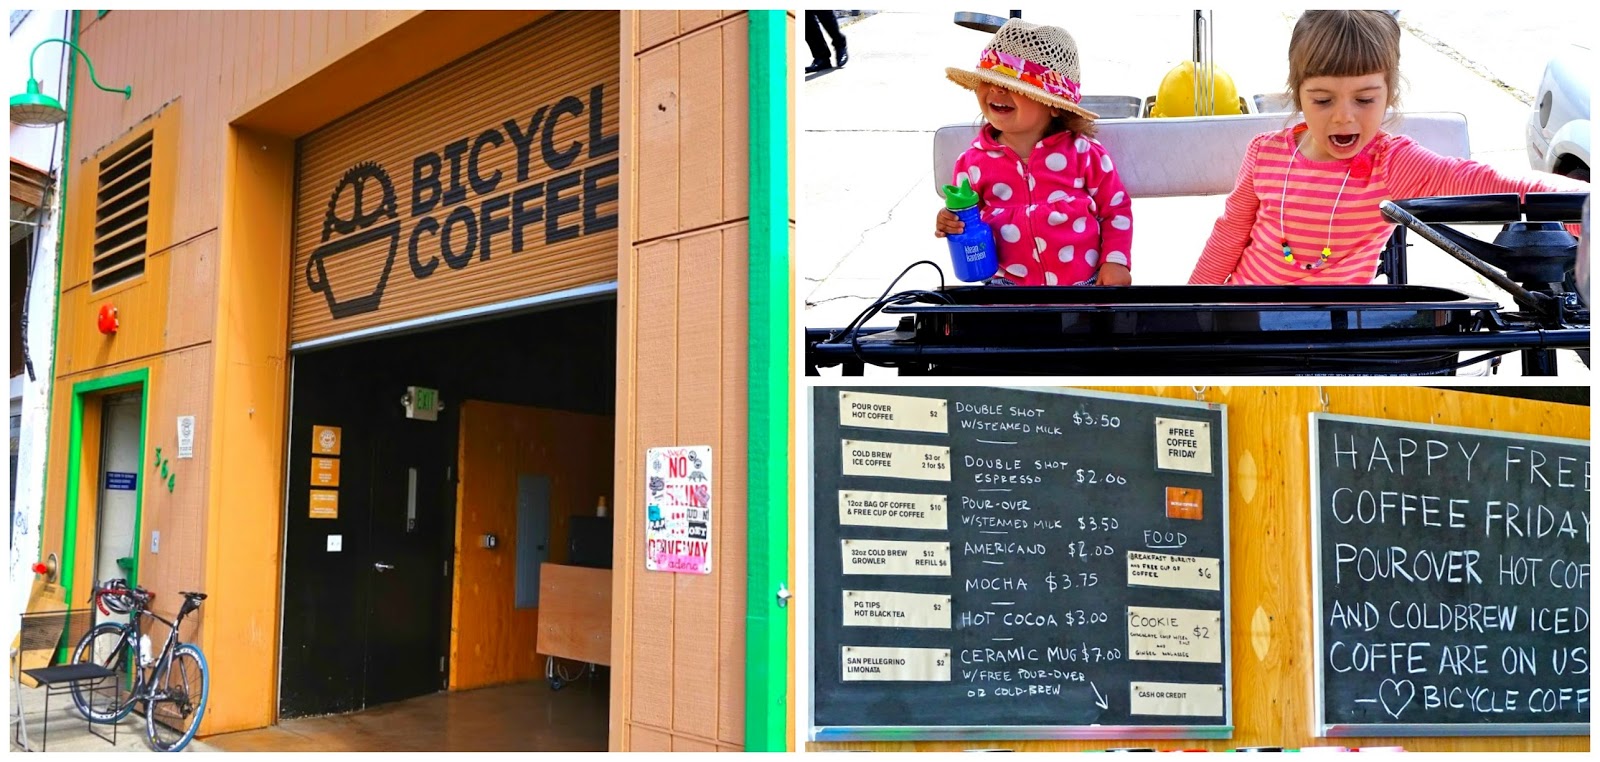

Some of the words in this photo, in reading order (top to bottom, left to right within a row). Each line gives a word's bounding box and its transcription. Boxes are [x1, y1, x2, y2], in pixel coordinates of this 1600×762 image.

[408, 157, 619, 279] COFFEE
[416, 390, 434, 409] EXIT
[852, 402, 872, 410] POUR
[873, 404, 892, 412] OVER
[930, 410, 938, 418] $2
[868, 412, 894, 420] COFFEE
[956, 402, 1003, 415] DOUBLE
[1010, 407, 1045, 418] SHOT
[1072, 410, 1121, 428] $3.50
[961, 418, 1030, 433] W/STEAMED
[1036, 426, 1063, 435] MILK
[1169, 427, 1195, 438] #FREE
[1166, 438, 1198, 448] COFFEE
[1168, 448, 1196, 458] FRIDAY
[1334, 433, 1480, 482] HAPPY
[669, 456, 687, 478] NO
[852, 458, 864, 466] ICE
[937, 462, 946, 470] $5
[964, 455, 1022, 470] DOUBLE
[1034, 460, 1068, 470] SHOT
[974, 473, 1042, 484] ESPRESSO
[1076, 469, 1127, 486] $2.00
[864, 500, 878, 508] BAG
[890, 502, 916, 510] COFFEE
[962, 496, 1031, 510] POUR-OVER
[1332, 488, 1470, 528] COFFEE
[899, 510, 924, 518] COFFEE
[961, 514, 1028, 528] W/STEAMED
[1033, 520, 1063, 529] MILK
[1078, 516, 1119, 532] $3.50
[1144, 530, 1188, 546] FOOD
[964, 542, 1046, 556] AMERICANO
[1068, 541, 1114, 558] $2.00
[1130, 553, 1167, 562] BREAKFAST
[1336, 543, 1482, 584] POUROVER
[1500, 554, 1543, 587] HOT
[1132, 570, 1158, 578] COFFEE
[1198, 568, 1212, 579] $6
[965, 578, 1028, 592] MOCHA
[1045, 572, 1098, 593] $3.75
[870, 610, 892, 618] BLACK
[962, 610, 996, 627] HOT
[1003, 612, 1058, 627] COCOA
[1065, 610, 1108, 626] $3.00
[1330, 600, 1379, 631] AND
[1389, 600, 1518, 633] COLDBREW
[1531, 607, 1589, 634] ICED
[1130, 614, 1179, 628] COOKIE
[1193, 624, 1210, 640] $2
[960, 646, 1039, 664] CERAMIC
[1047, 646, 1077, 662] MUG
[1081, 642, 1122, 662] $7.00
[1330, 640, 1430, 674] COFFE
[1439, 645, 1489, 676] ARE
[1502, 646, 1536, 676] ON
[1553, 647, 1588, 675] US
[862, 658, 906, 666] PELLEGRINO
[1017, 668, 1086, 682] POUR-OVER
[967, 689, 986, 698] OR
[994, 684, 1061, 696] COLD-BREW
[1423, 686, 1519, 713] BICYCLE
